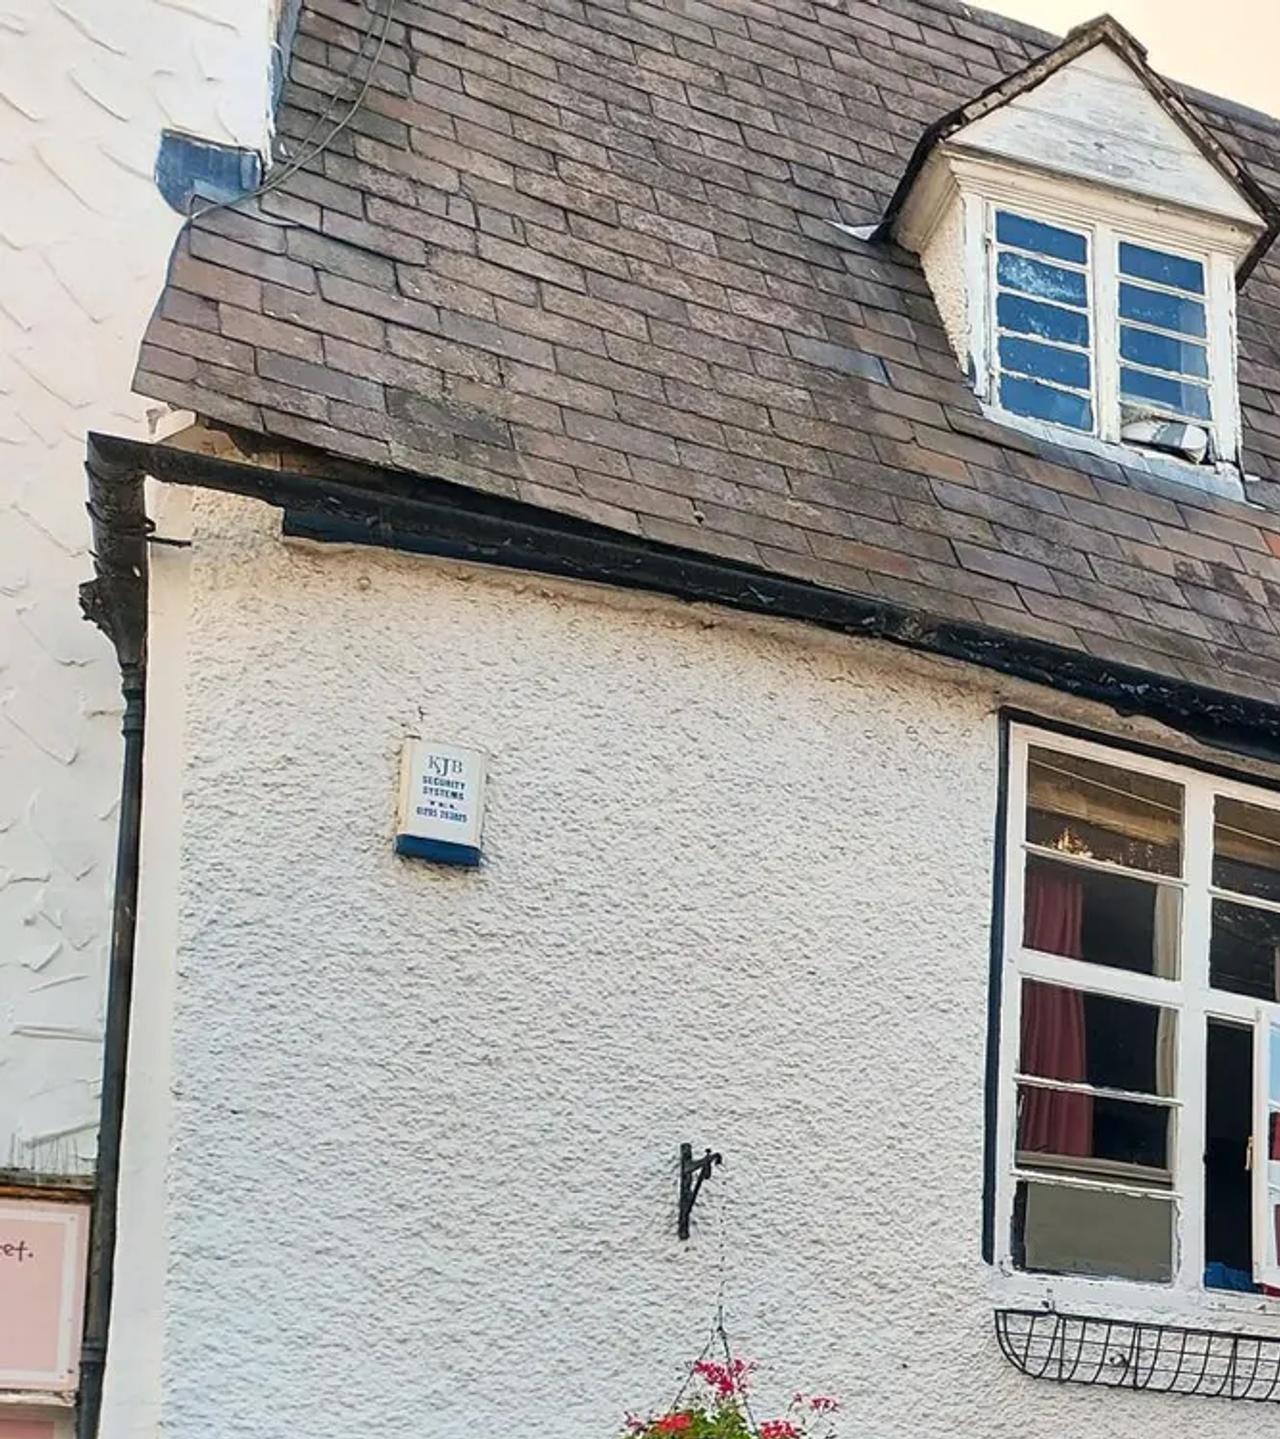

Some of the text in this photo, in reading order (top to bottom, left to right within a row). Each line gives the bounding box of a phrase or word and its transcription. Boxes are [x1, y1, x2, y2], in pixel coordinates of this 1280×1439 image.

[428, 755, 463, 776] KJB
[423, 776, 465, 789] SECURITY
[423, 786, 464, 800] SYSTEMS
[0, 1239, 34, 1262] et.
